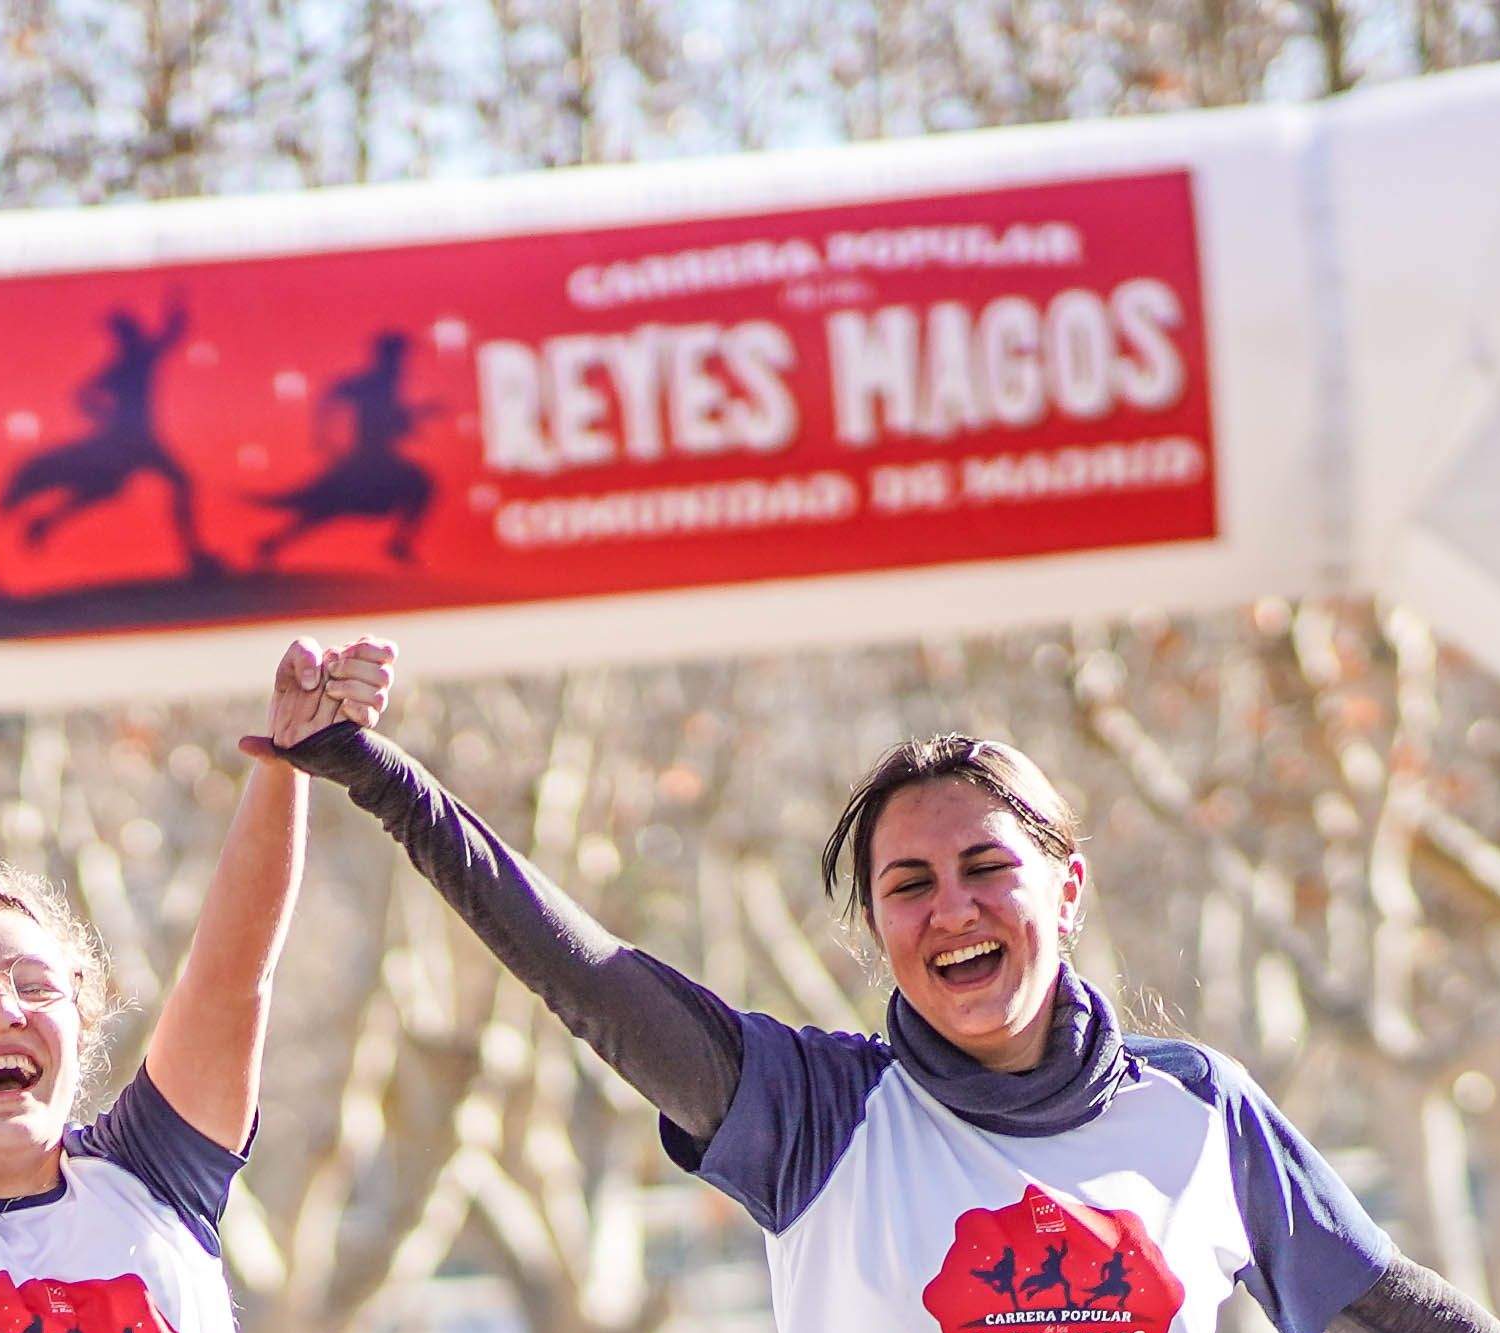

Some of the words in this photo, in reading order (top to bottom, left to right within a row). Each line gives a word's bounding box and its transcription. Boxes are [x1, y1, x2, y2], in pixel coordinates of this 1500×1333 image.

[476, 320, 797, 475] REYES
[826, 277, 1187, 447] MAGOS
[985, 1311, 1057, 1325] CARRERA
[1060, 1310, 1131, 1323] POPULAR
